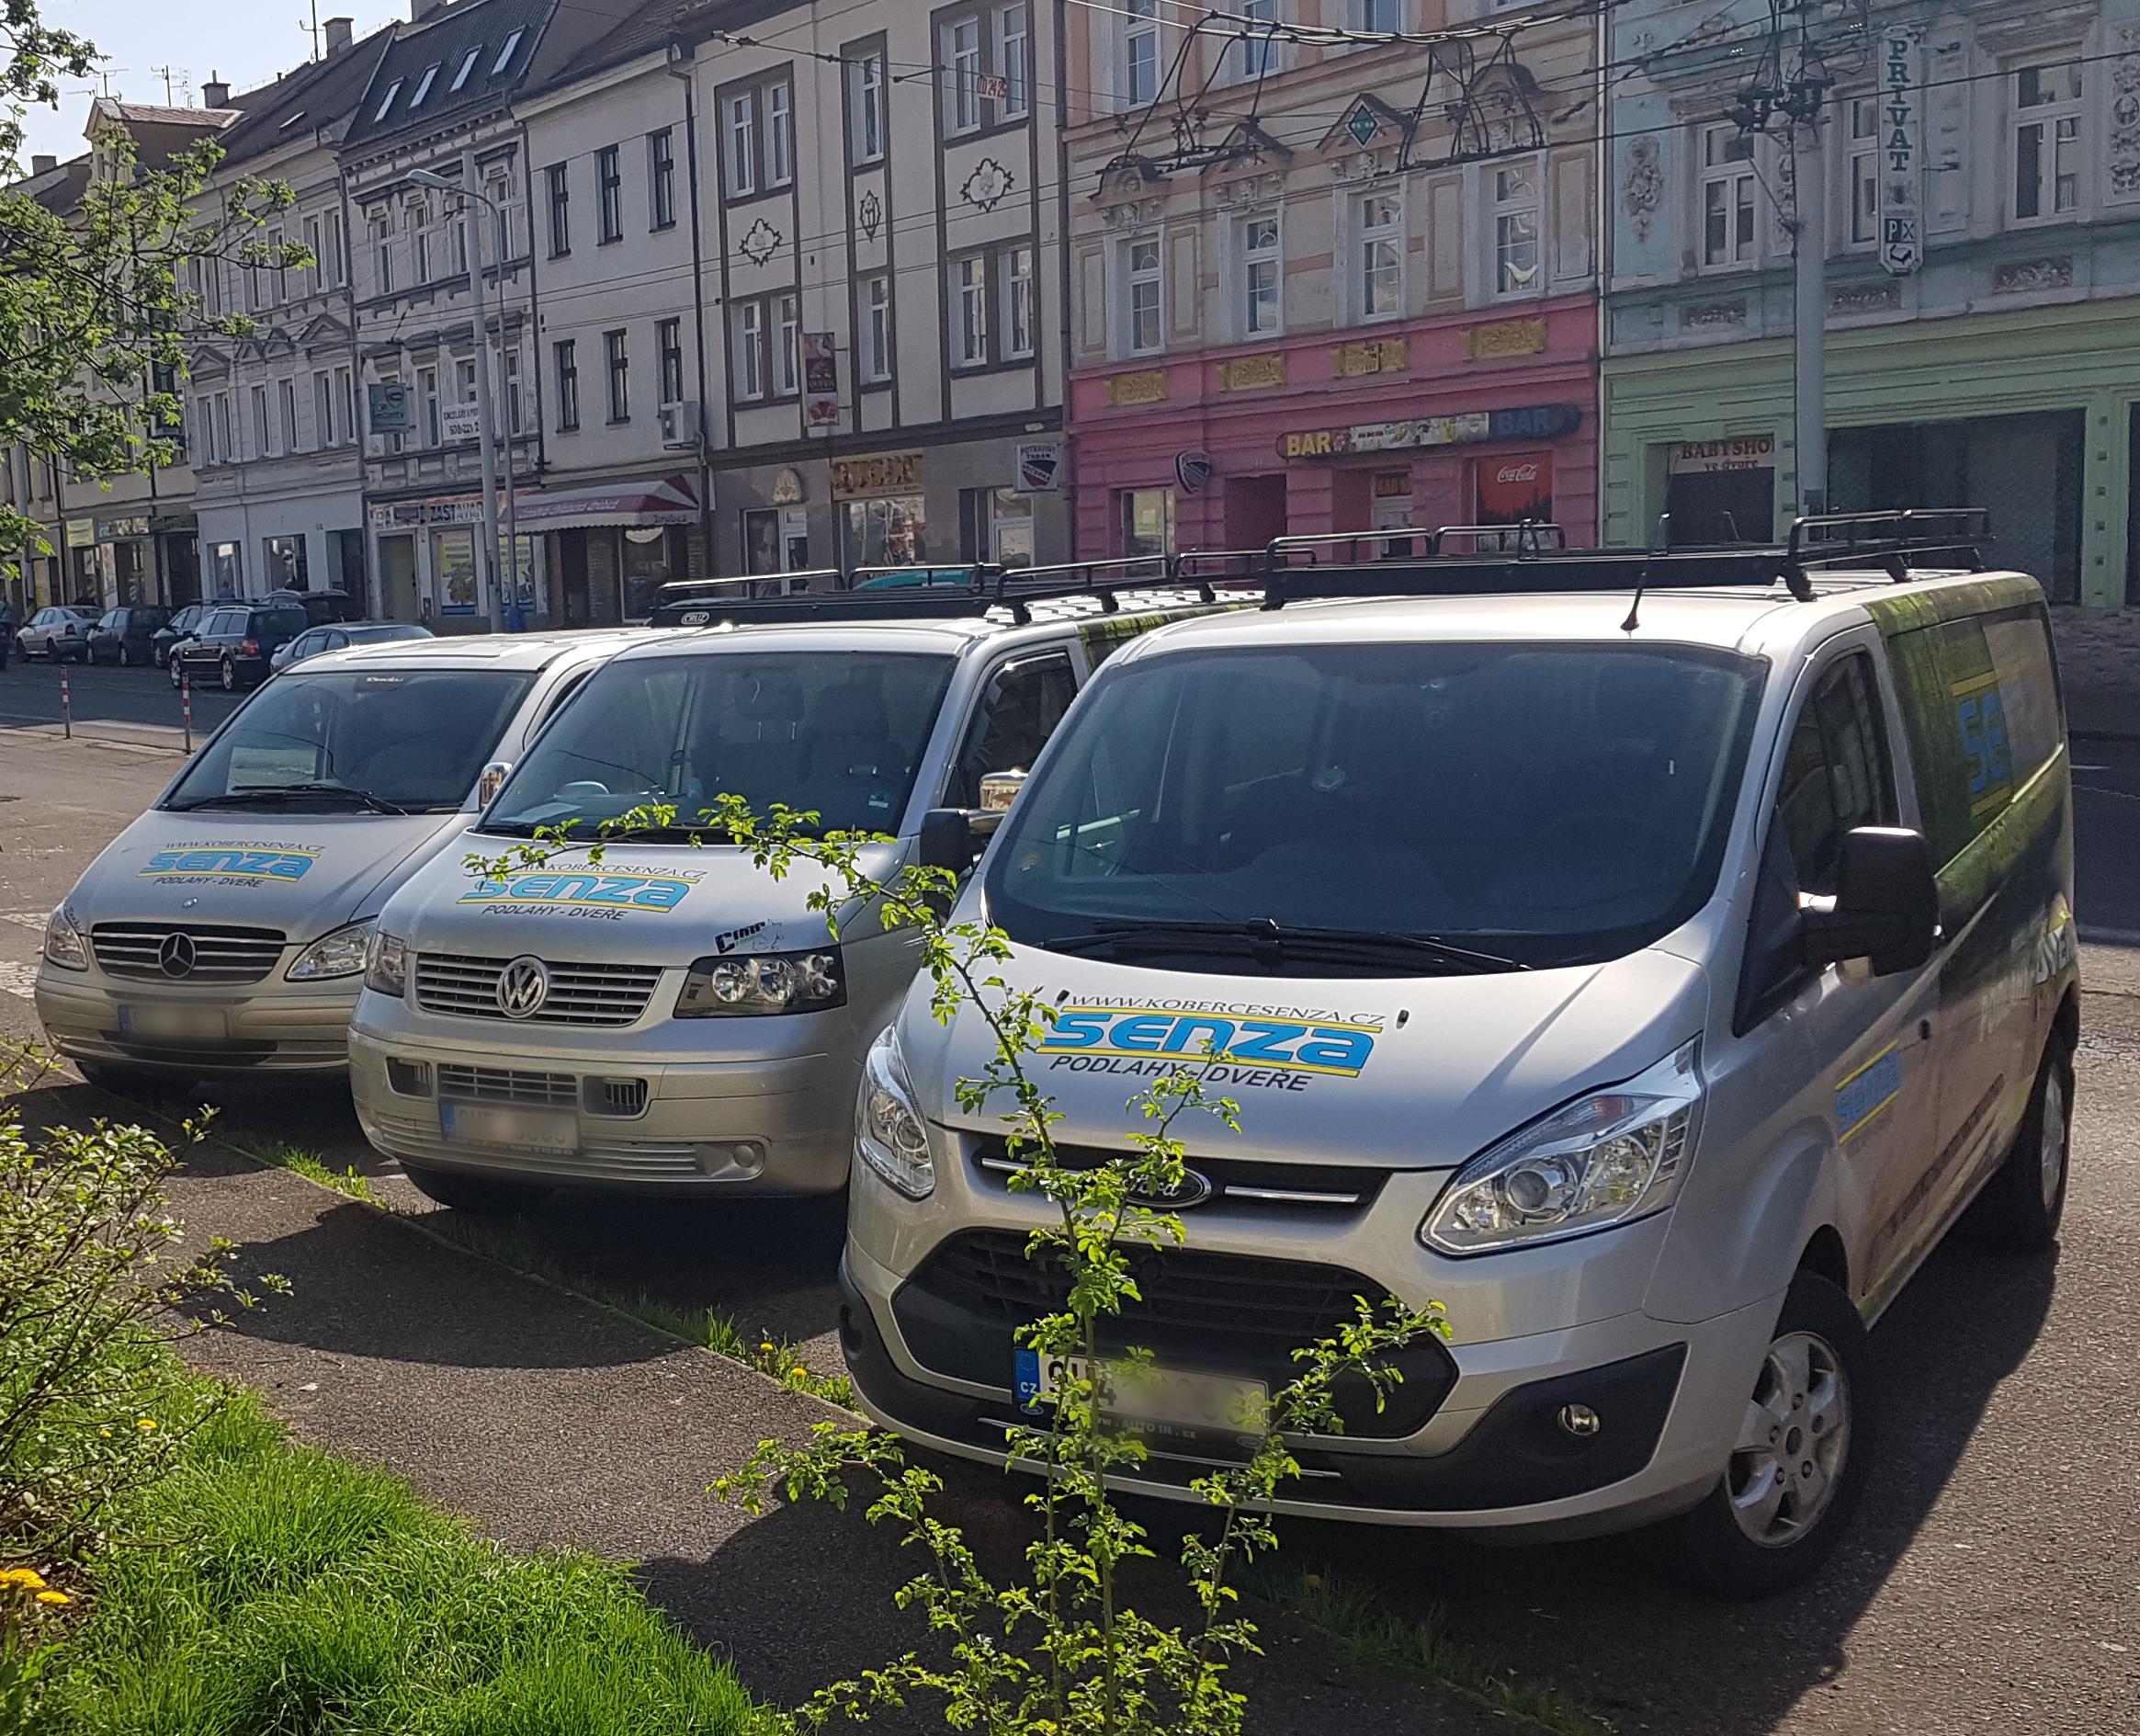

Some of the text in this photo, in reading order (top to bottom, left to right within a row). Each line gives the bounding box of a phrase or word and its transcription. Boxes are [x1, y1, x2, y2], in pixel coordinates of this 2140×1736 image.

[1885, 40, 1913, 172] PRIVAT
[1497, 407, 1552, 437] BAR
[1286, 432, 1331, 457] BAR
[482, 904, 561, 915] PODLAHY
[1071, 994, 1387, 1027] WWW.KOBERCESENZA.CZ
[1043, 1013, 1376, 1070] senza
[1048, 1055, 1189, 1078] PODLAHY
[1206, 1065, 1313, 1093] DVEŘE
[1020, 1381, 1037, 1393] CZ
